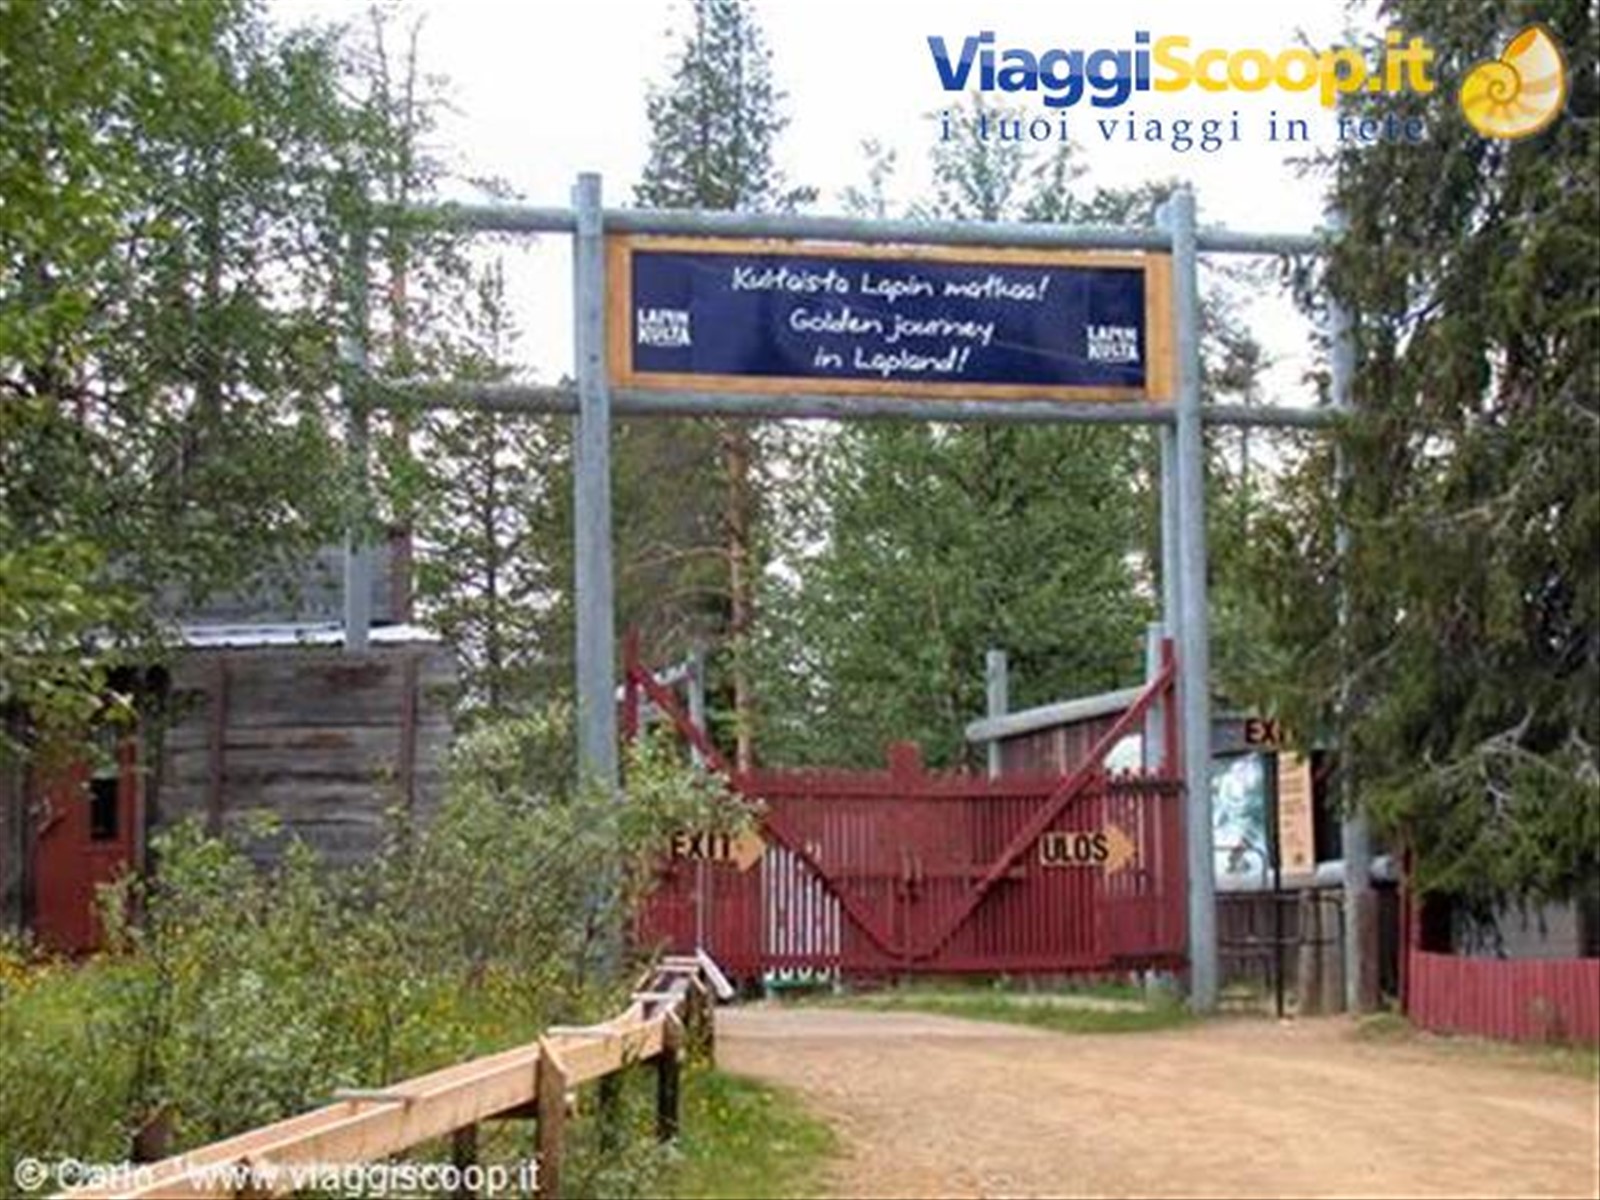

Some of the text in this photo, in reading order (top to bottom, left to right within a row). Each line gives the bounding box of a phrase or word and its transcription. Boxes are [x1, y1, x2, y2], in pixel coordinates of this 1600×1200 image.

[861, 273, 934, 303] Lapin
[943, 273, 1049, 301] matkaa!
[789, 307, 995, 346] Golden journey
[813, 346, 970, 377] in Lapland!
[671, 831, 731, 858] EXIT
[1043, 833, 1109, 862] ULOS
